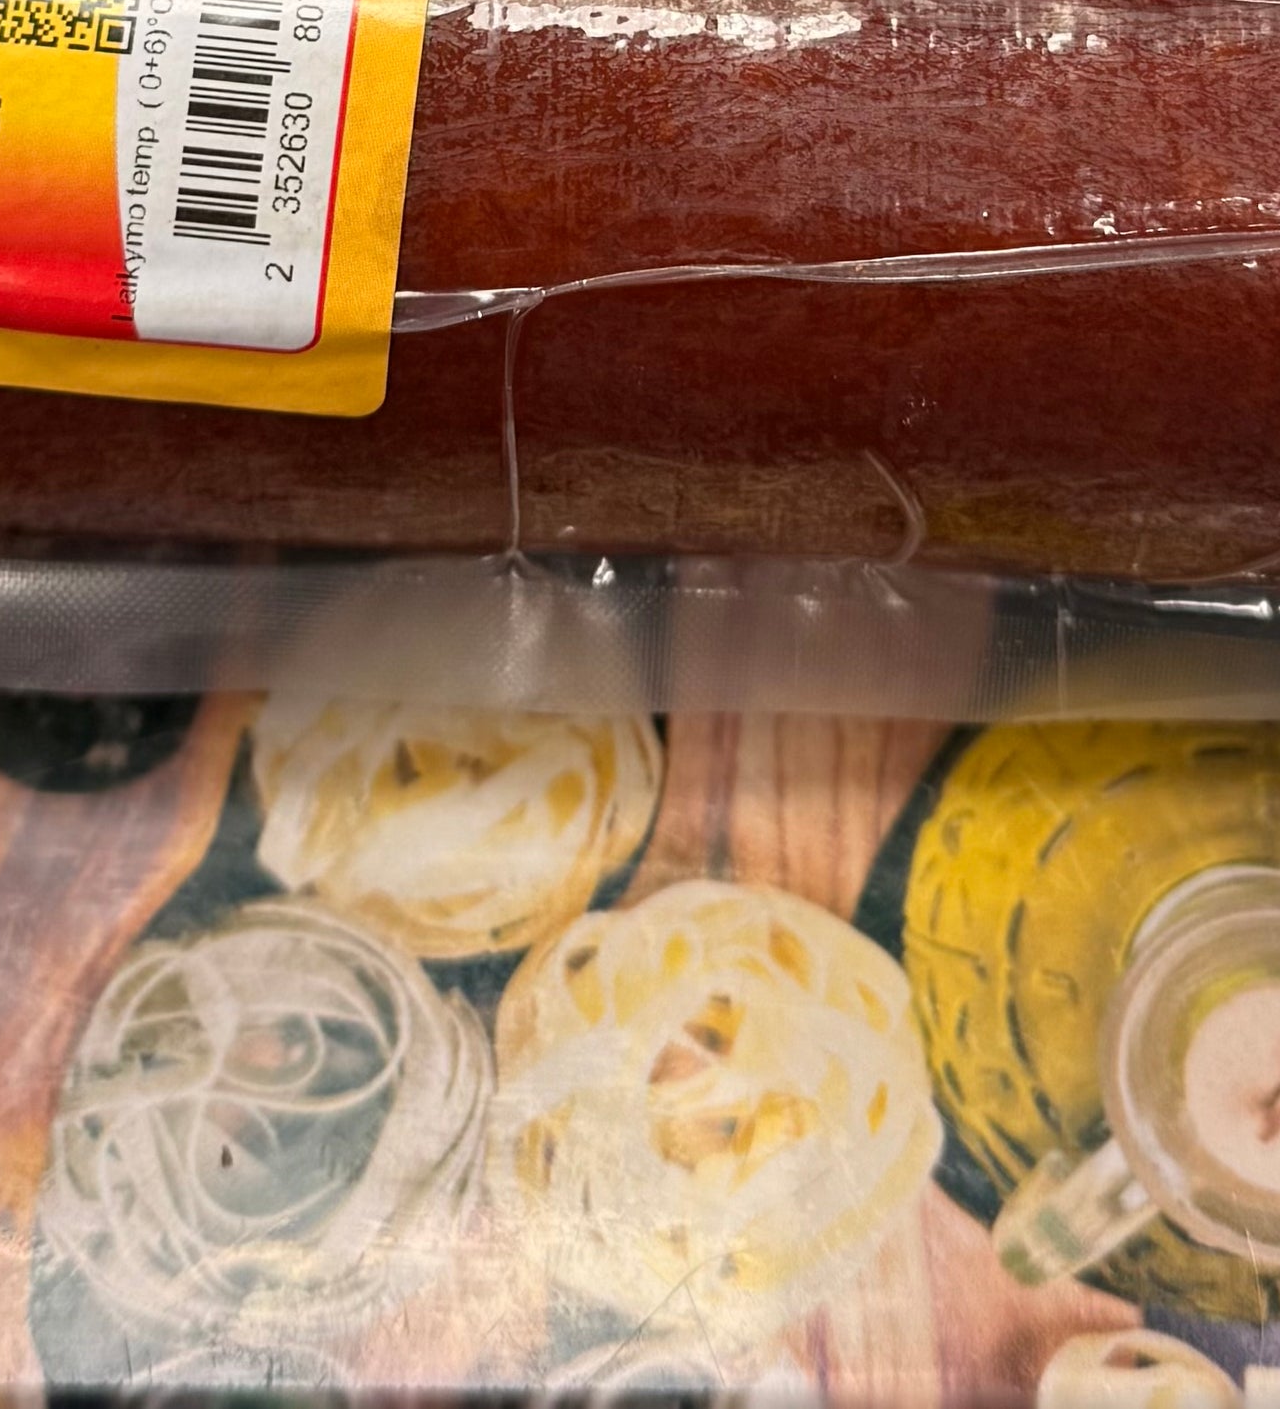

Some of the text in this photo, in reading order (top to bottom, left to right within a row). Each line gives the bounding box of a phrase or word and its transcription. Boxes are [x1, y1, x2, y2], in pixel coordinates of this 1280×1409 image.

[271, 90, 314, 214] 352630
[110, 203, 148, 323] Laikymo
[264, 262, 296, 283] 2
